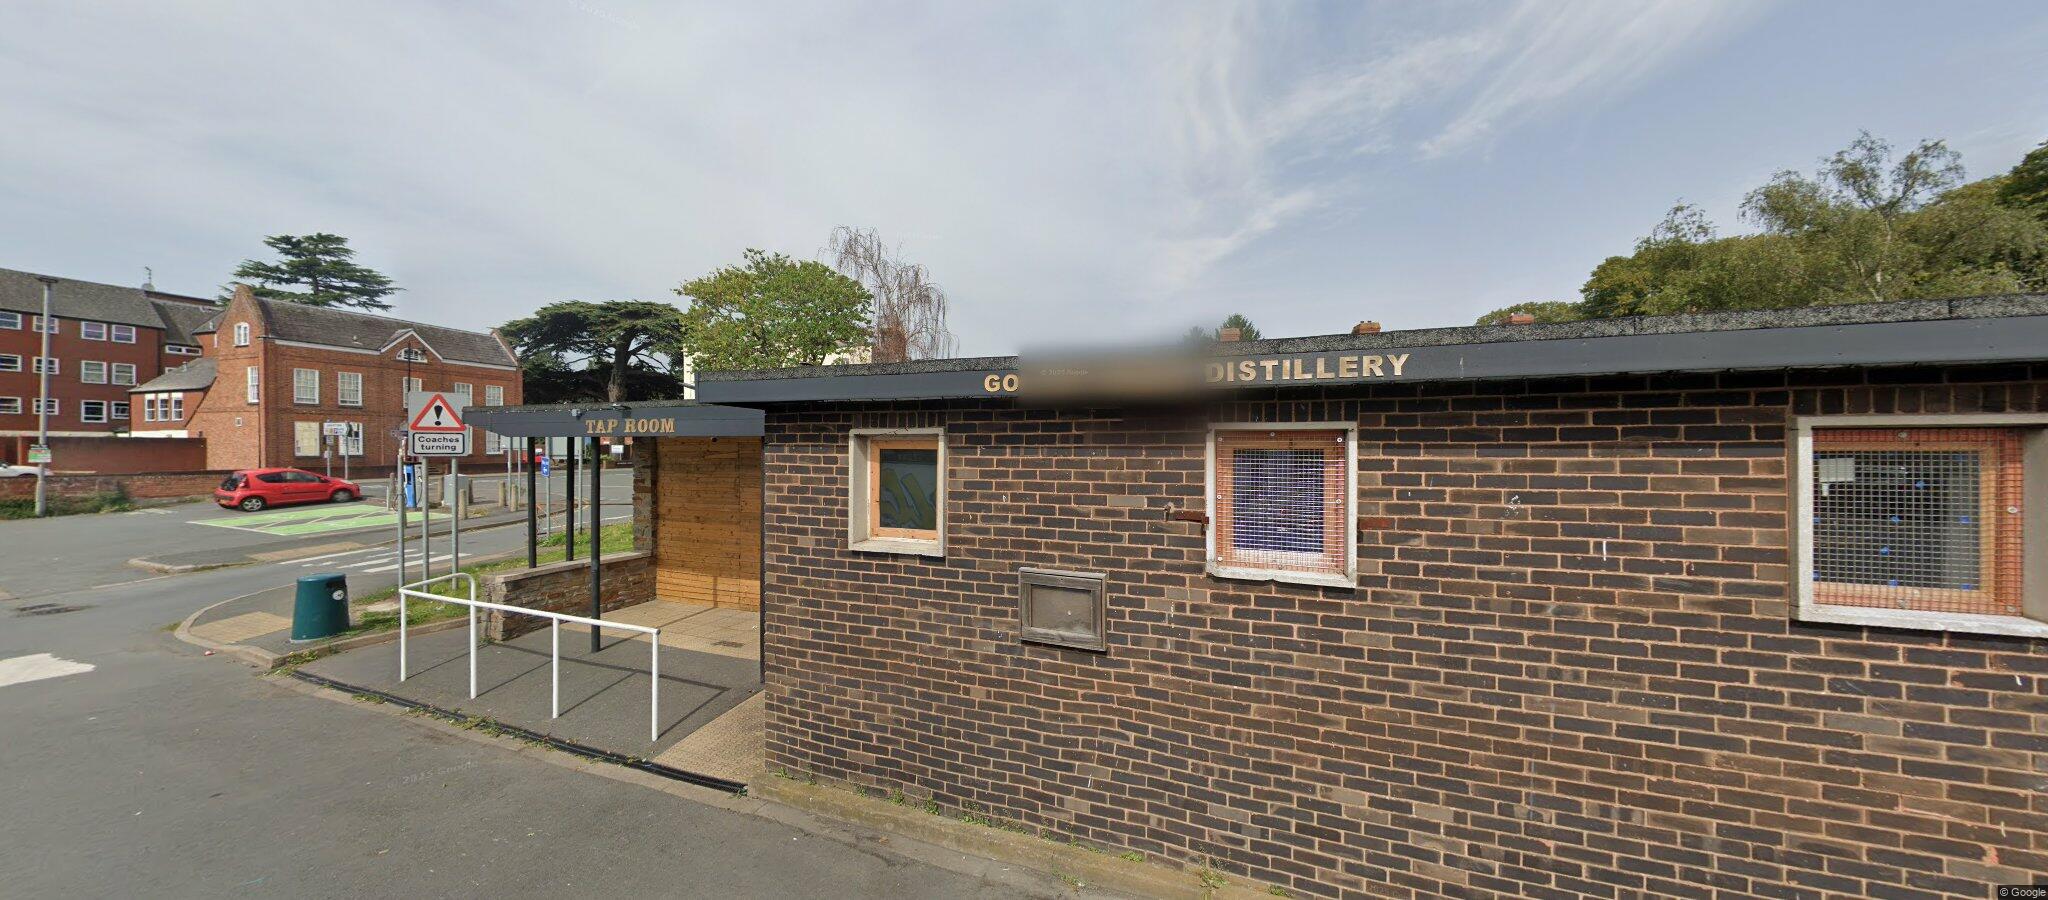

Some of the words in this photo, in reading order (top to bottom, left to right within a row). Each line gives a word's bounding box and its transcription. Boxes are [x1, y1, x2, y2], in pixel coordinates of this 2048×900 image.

[1204, 353, 1411, 383] DISTILLERY
[585, 418, 619, 434] TAP
[624, 417, 675, 433] ROOM
[421, 444, 457, 452] turning
